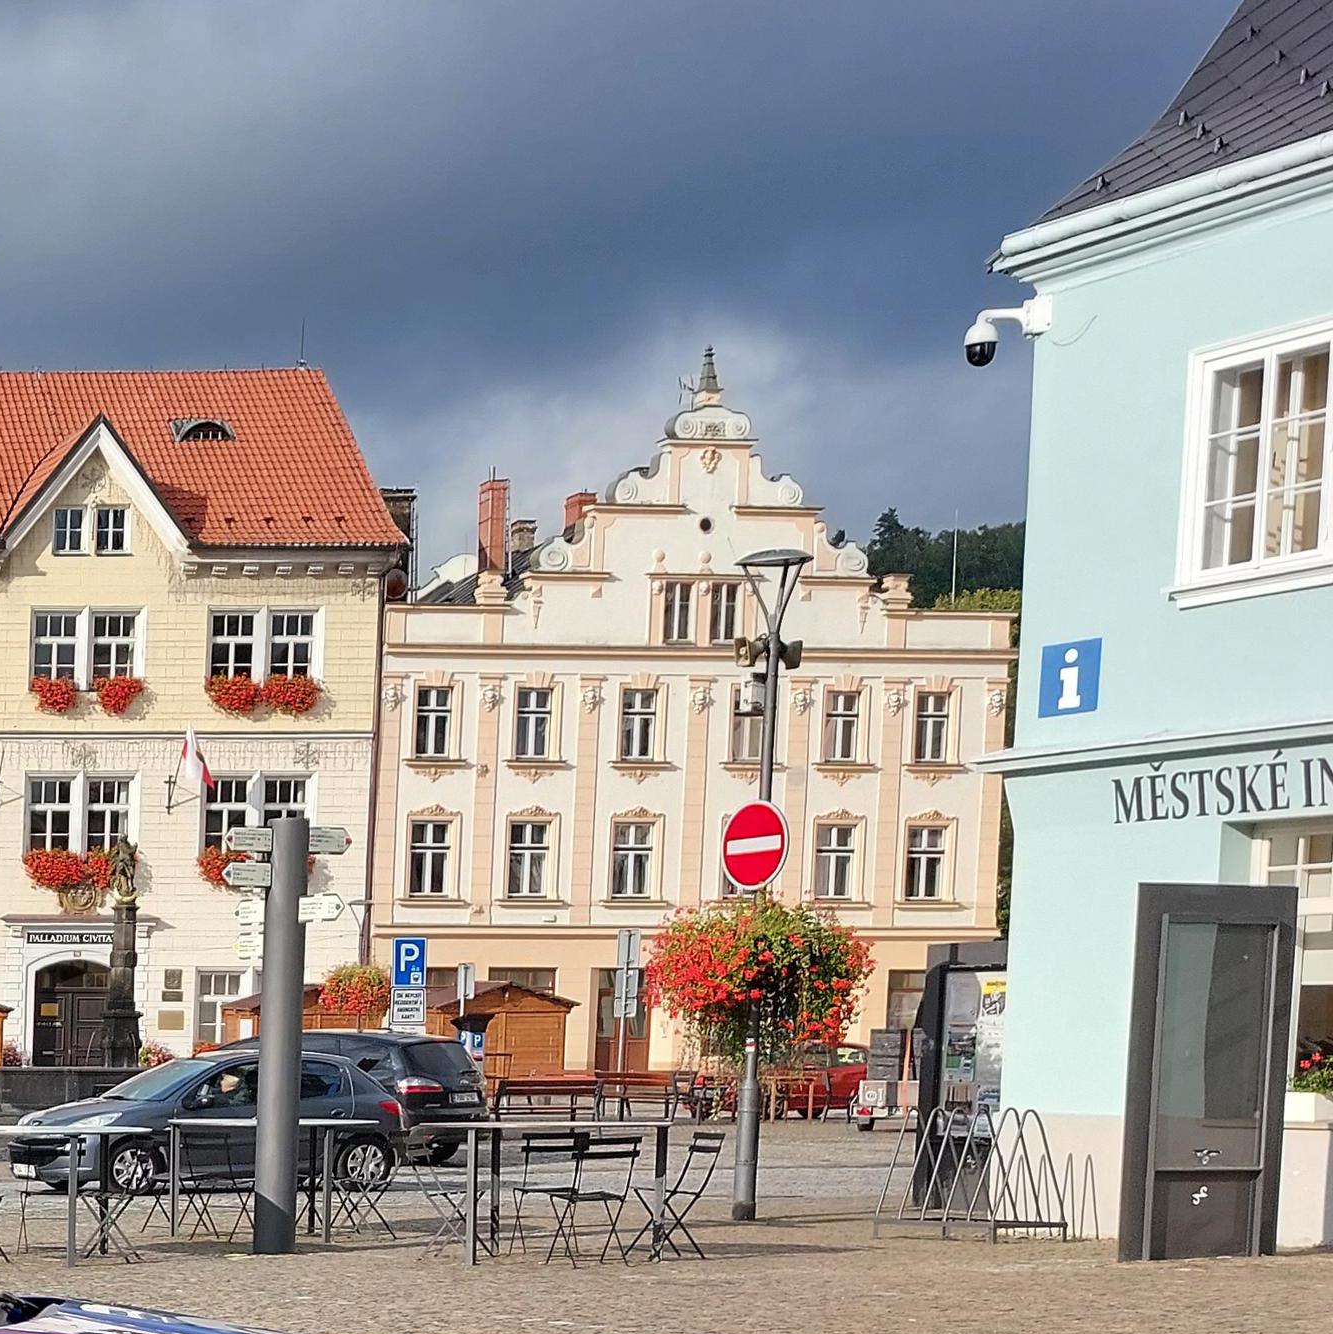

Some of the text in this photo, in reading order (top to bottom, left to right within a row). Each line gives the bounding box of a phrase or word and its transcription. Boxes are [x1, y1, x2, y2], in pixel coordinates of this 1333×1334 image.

[1111, 749, 1290, 825] MĚSTSKÉ
[29, 934, 113, 943] PALLADIUM CIVITA
[400, 943, 420, 972] P
[474, 1035, 481, 1047] P
